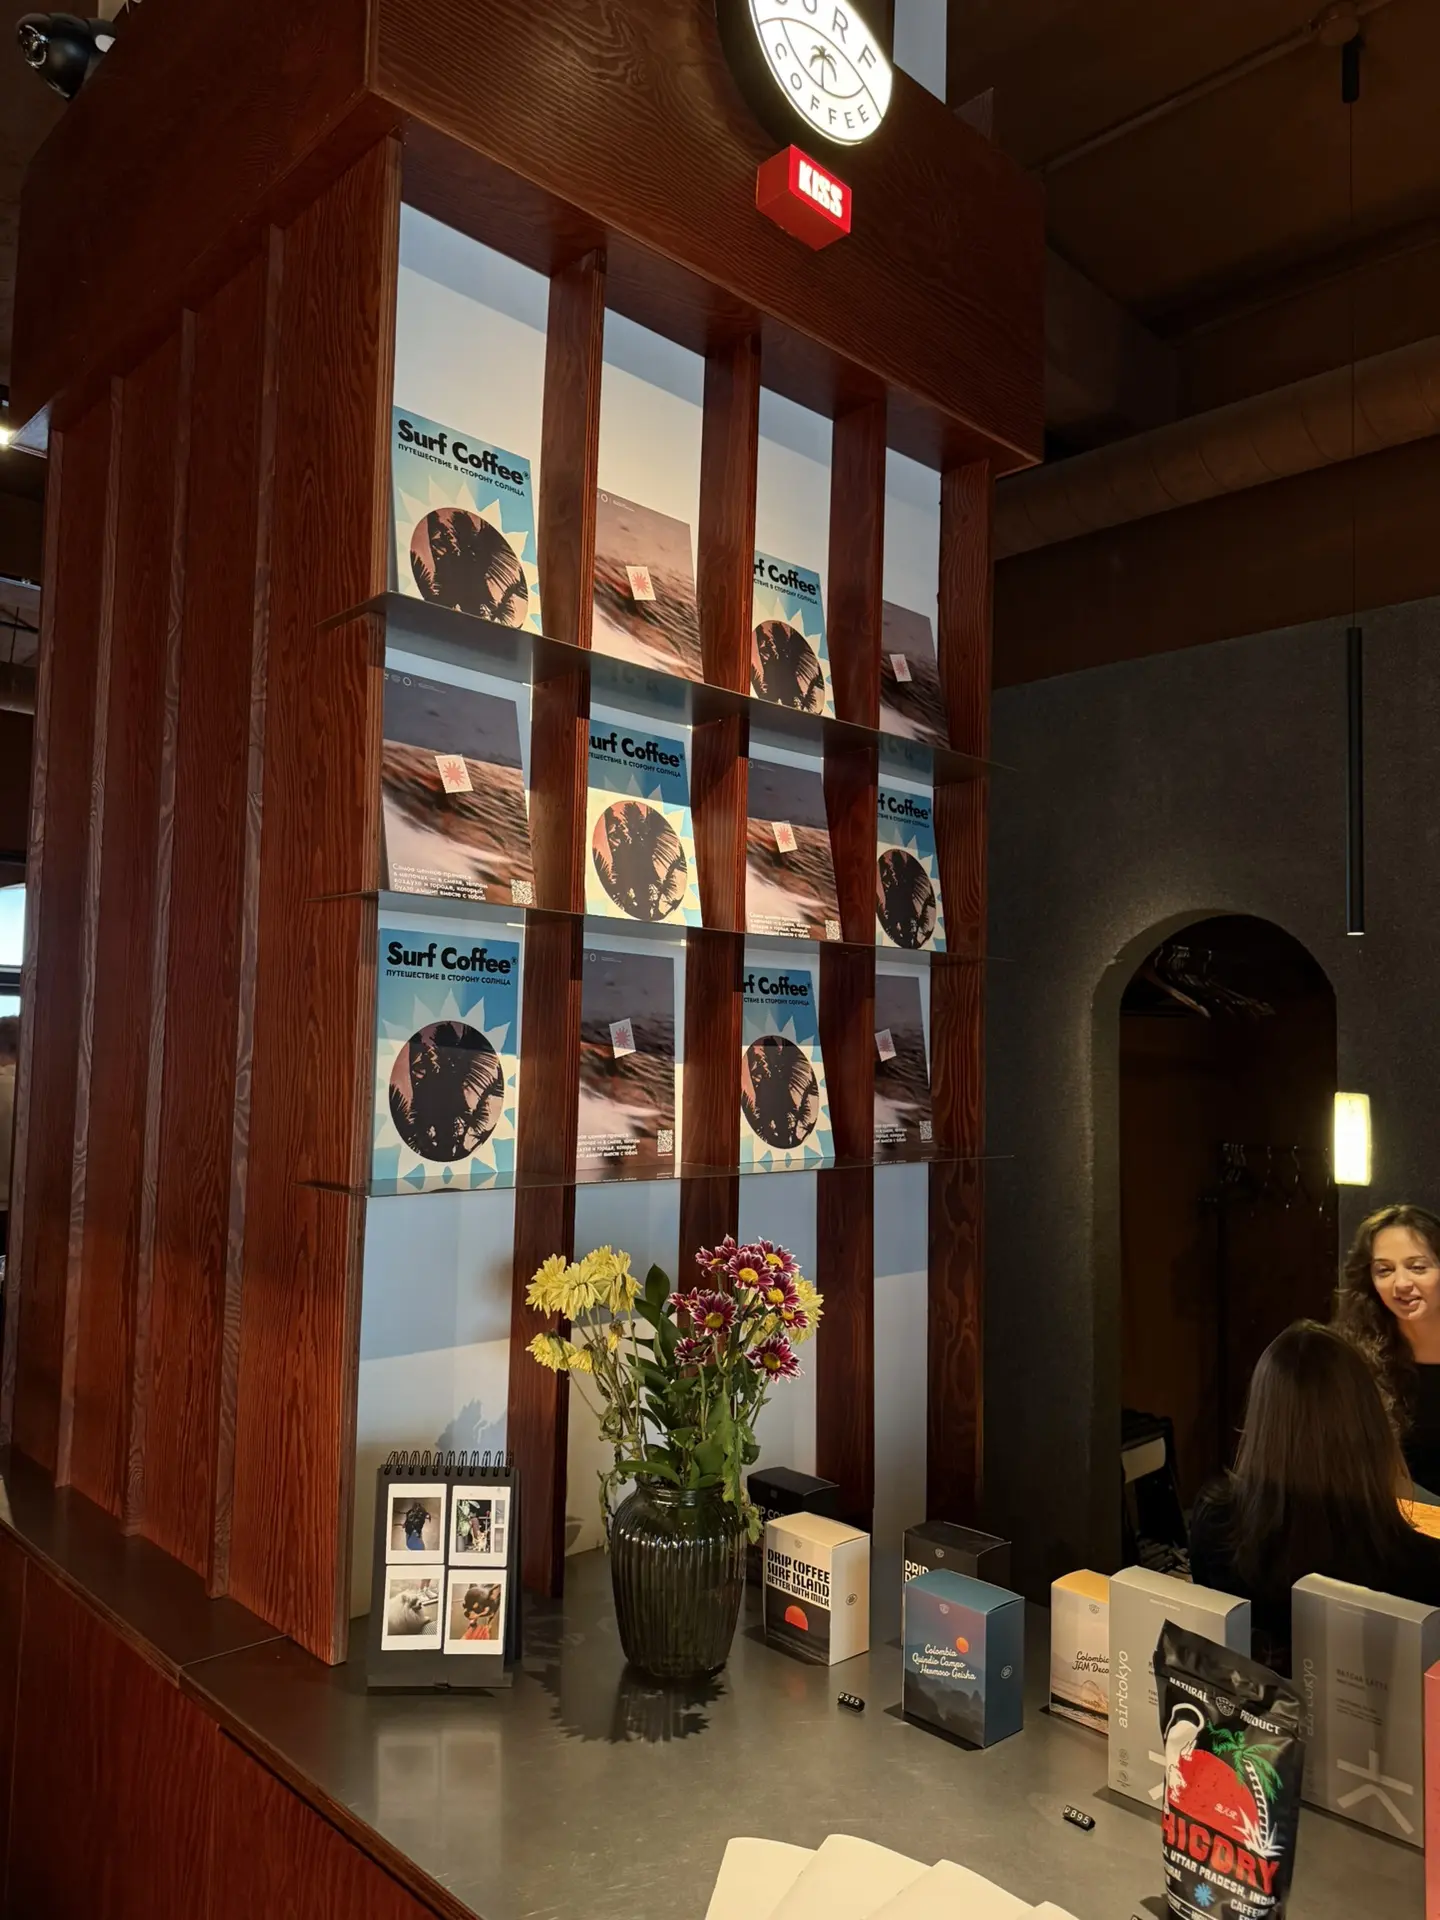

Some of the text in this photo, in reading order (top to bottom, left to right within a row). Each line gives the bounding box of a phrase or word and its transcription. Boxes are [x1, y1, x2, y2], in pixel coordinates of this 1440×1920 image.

[775, 0, 877, 69] URF
[775, 43, 869, 129] COFFEE
[798, 159, 842, 218] KISS
[398, 419, 447, 455] Surf
[398, 443, 452, 468] ПУТЕШЕСТВИЕ
[460, 467, 493, 484] СТОРОНУ
[495, 480, 525, 497] СОЛНЦА
[588, 732, 617, 753] urf
[387, 942, 437, 967] Surf
[386, 969, 439, 980] ПУТЕШЕСТВИЕ
[448, 974, 480, 983] СТОРОНУ
[482, 978, 511, 986] СОЛНЦА
[768, 1549, 830, 1584] DRIP COFFEE
[768, 1562, 830, 1597] SURF ISLAND
[905, 1572, 917, 1582] D
[768, 1574, 829, 1607] BETTER WITH MILK
[912, 1652, 966, 1668] Quindio Campo
[925, 1644, 958, 1657] Colombia
[920, 1664, 976, 1680] Hermoso Geisha
[1116, 1651, 1132, 1728] airtokyo
[1169, 1676, 1209, 1704] NATURAL
[1240, 1710, 1280, 1734] PRODUCT
[1170, 1849, 1198, 1873] UTTAR
